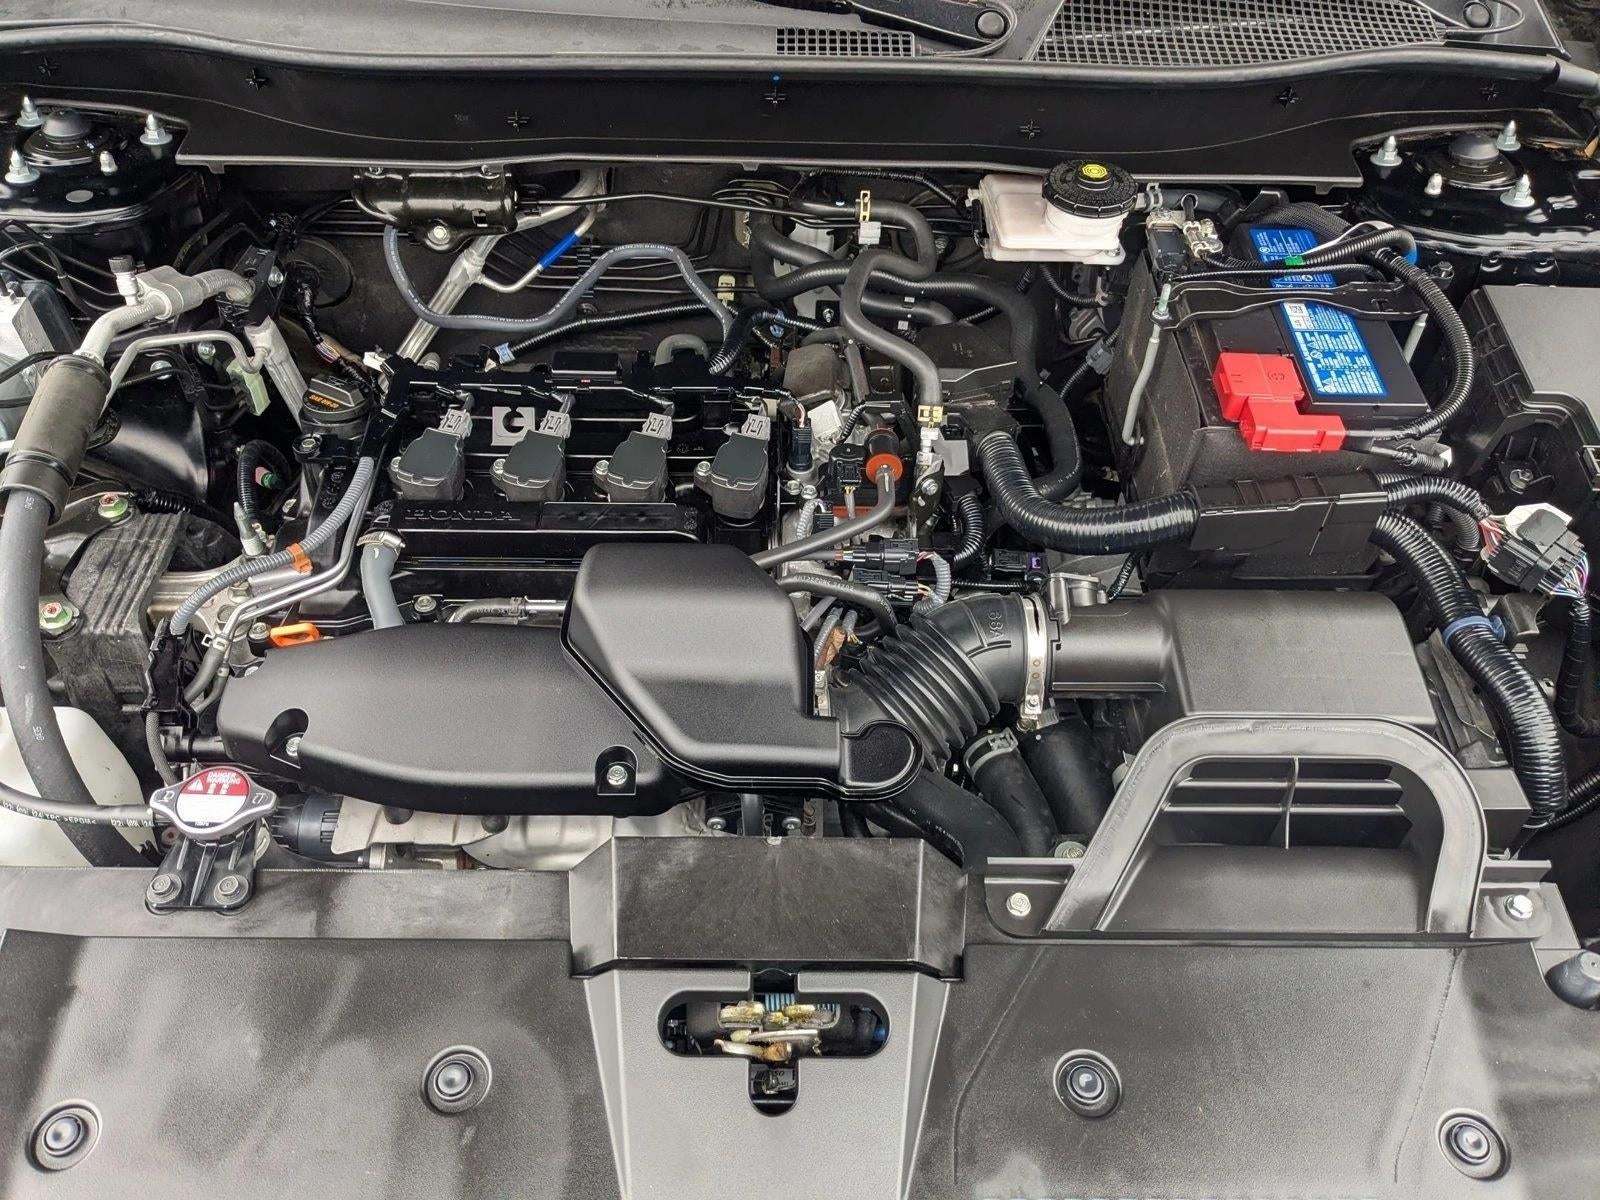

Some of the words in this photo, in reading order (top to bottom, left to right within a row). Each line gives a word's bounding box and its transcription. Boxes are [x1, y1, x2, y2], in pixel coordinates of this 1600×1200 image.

[405, 508, 521, 521] HONDA
[208, 771, 237, 779] DANGER
[206, 776, 241, 785] WARNING
